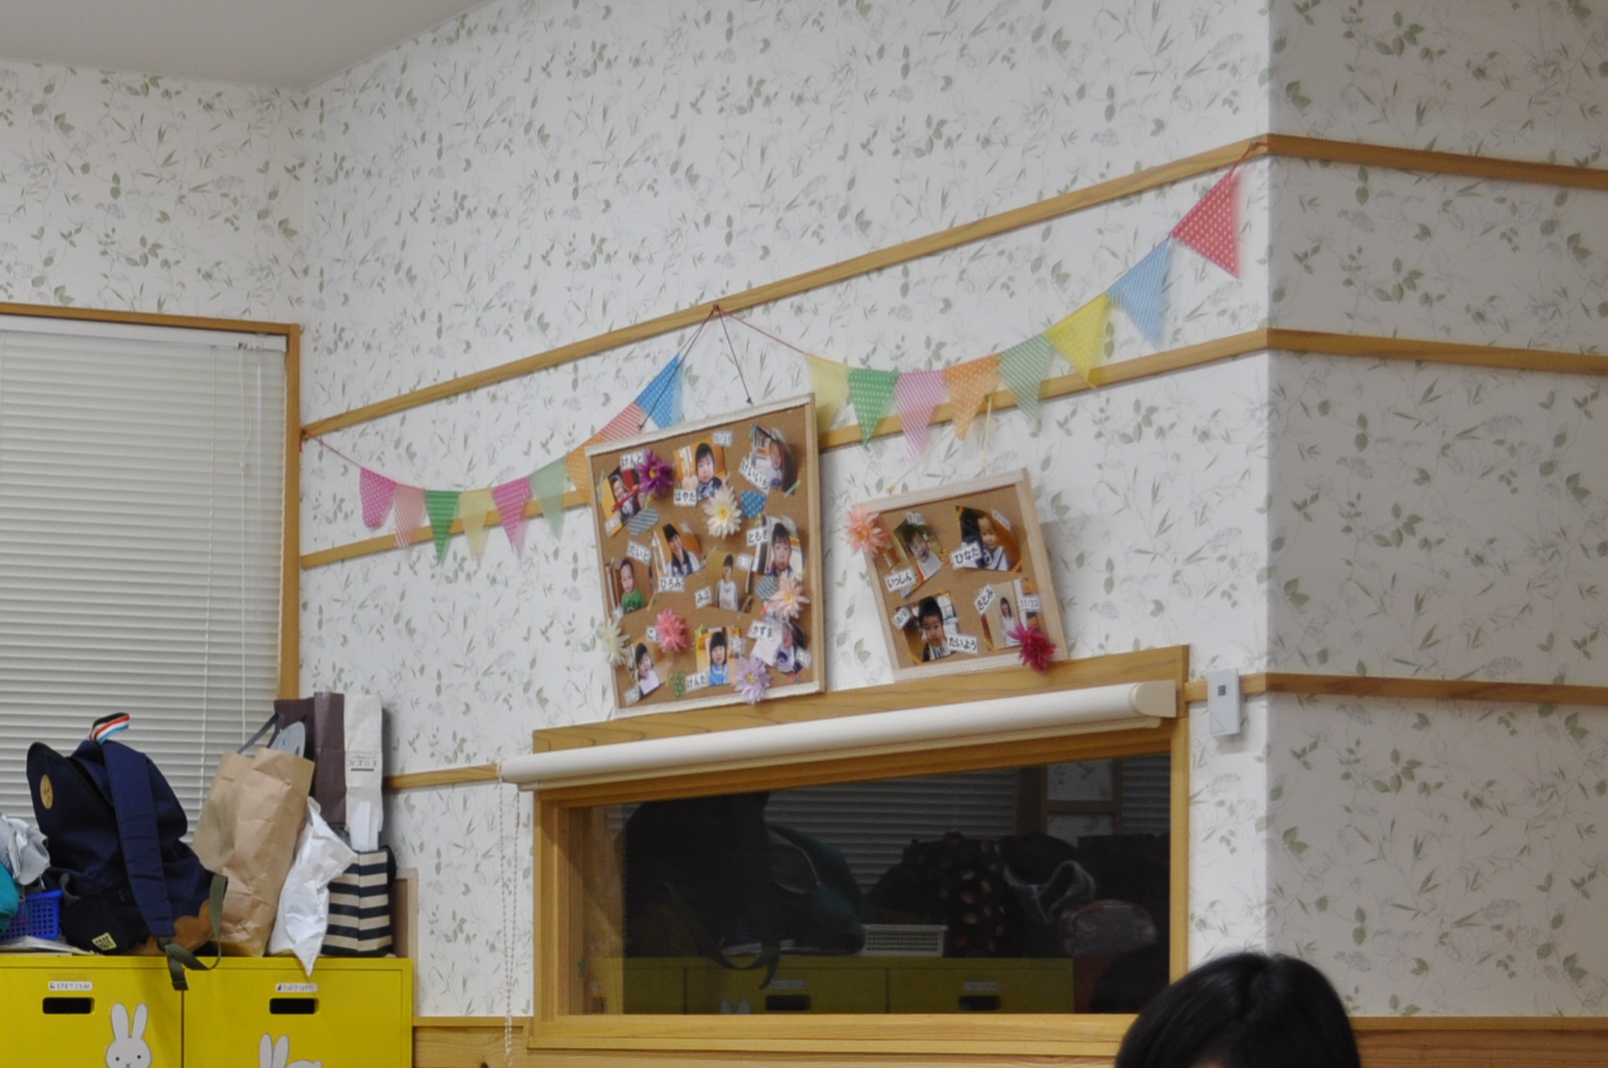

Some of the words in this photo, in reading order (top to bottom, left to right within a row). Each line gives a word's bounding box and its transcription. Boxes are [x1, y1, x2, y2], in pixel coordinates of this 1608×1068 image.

[953, 546, 982, 565] ひなた
[886, 574, 914, 588] いっしん
[976, 588, 995, 611] さとみ
[948, 635, 977, 650] たいよう
